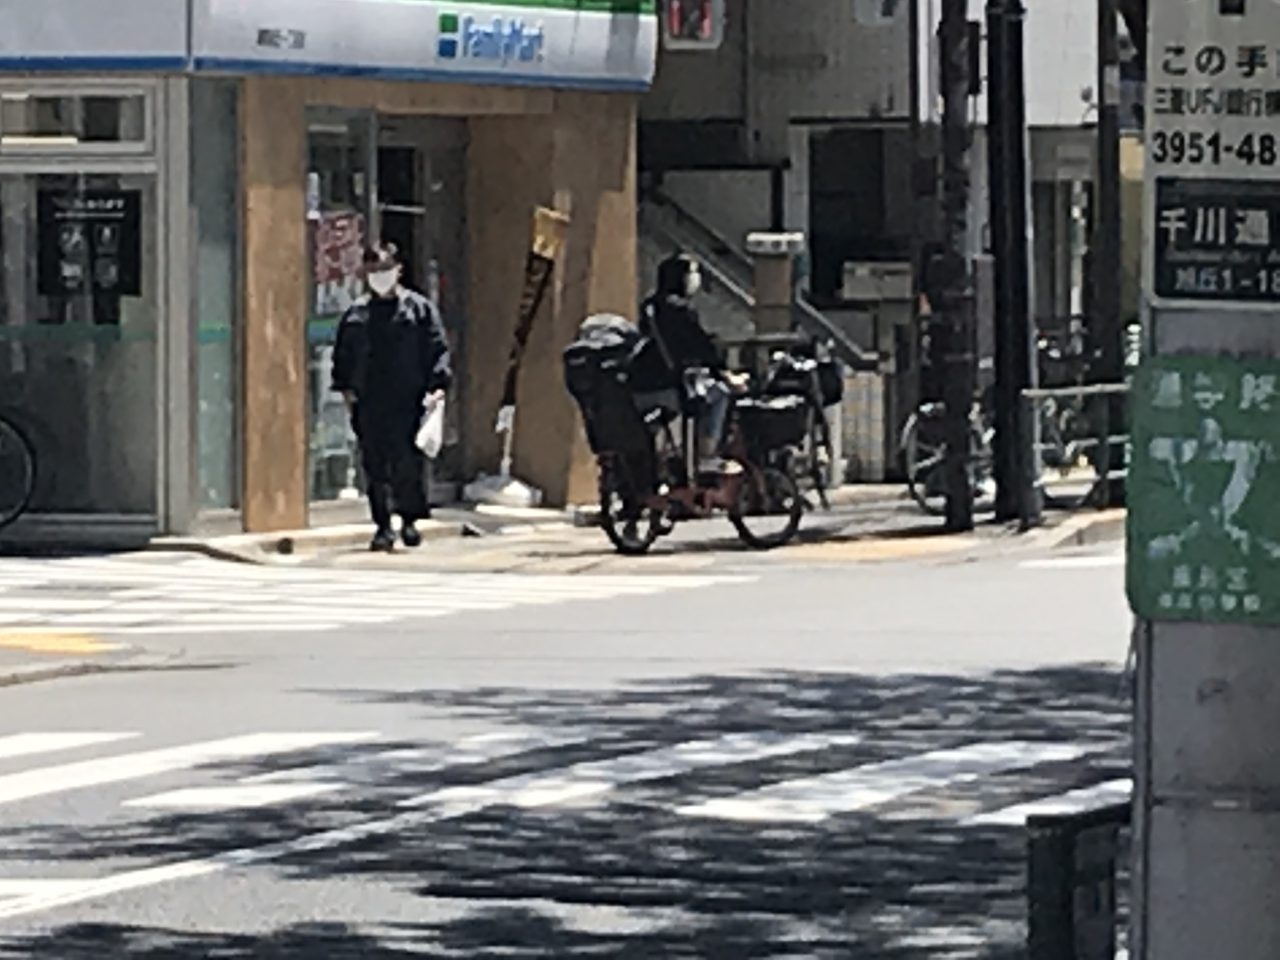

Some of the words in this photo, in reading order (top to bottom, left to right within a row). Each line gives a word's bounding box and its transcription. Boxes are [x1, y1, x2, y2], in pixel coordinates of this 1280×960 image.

[1162, 44, 1280, 78] この手
[1152, 132, 1276, 166] 3951-48
